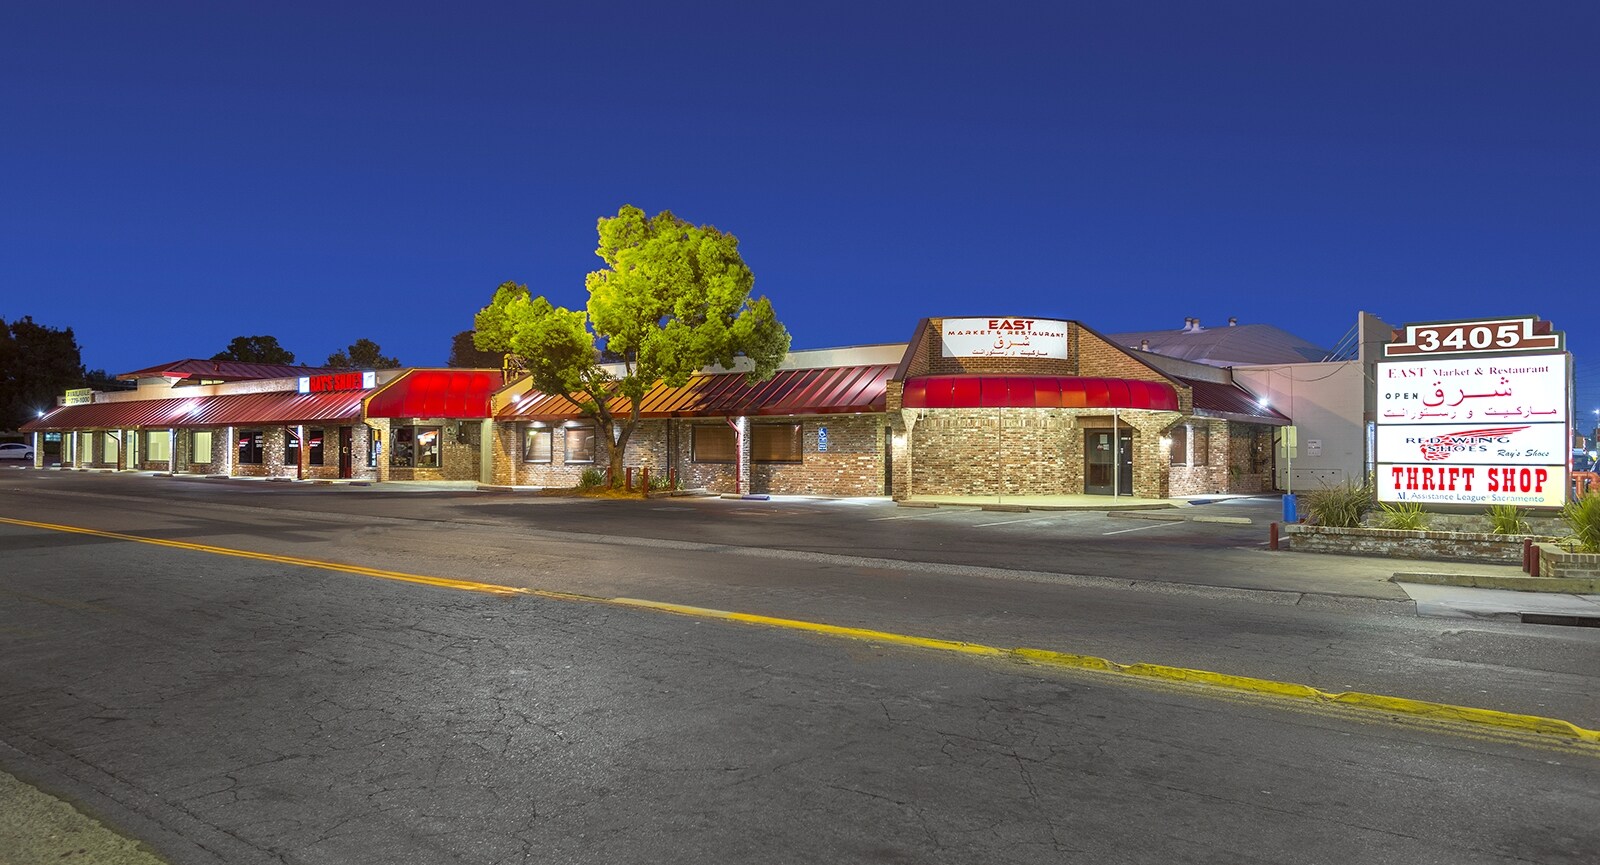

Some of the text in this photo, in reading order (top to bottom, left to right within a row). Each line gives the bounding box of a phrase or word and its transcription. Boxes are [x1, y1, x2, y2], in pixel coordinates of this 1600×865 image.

[989, 320, 1034, 330] EAST
[1417, 324, 1520, 351] 3405
[1388, 366, 1549, 378] EAST Market & Restaurant
[334, 372, 362, 391] SHOES
[1385, 392, 1418, 400] OPEN
[1423, 376, 1512, 407] شرق
[1497, 449, 1550, 458] Ray's Shoes
[1392, 466, 1548, 493] THRIFT SHOP
[1411, 492, 1454, 501] Assistance
[1491, 494, 1545, 503] Sacramento
